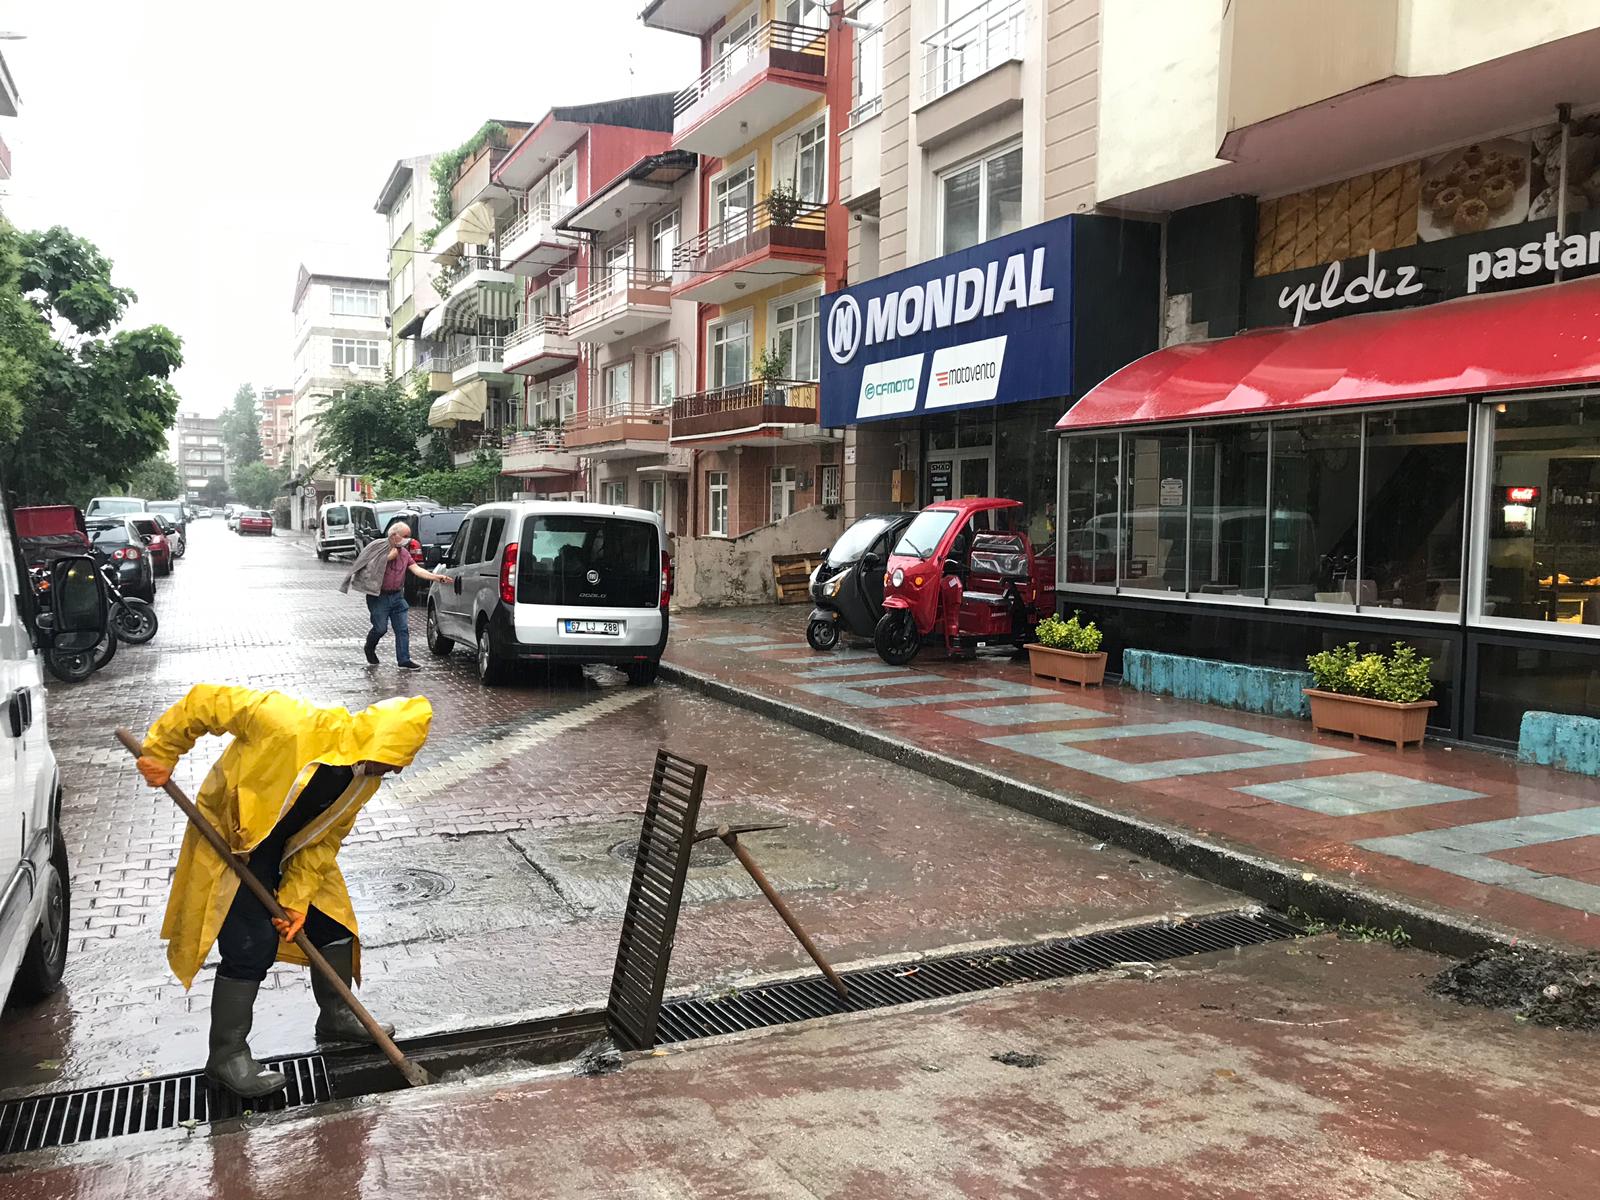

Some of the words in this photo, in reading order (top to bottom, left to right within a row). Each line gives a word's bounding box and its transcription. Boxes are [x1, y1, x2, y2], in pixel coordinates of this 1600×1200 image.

[865, 246, 1055, 346] MONDIAL
[948, 361, 996, 386] motovento
[875, 377, 915, 397] CFMOTO
[571, 621, 581, 631] 67
[586, 622, 596, 632] LJ
